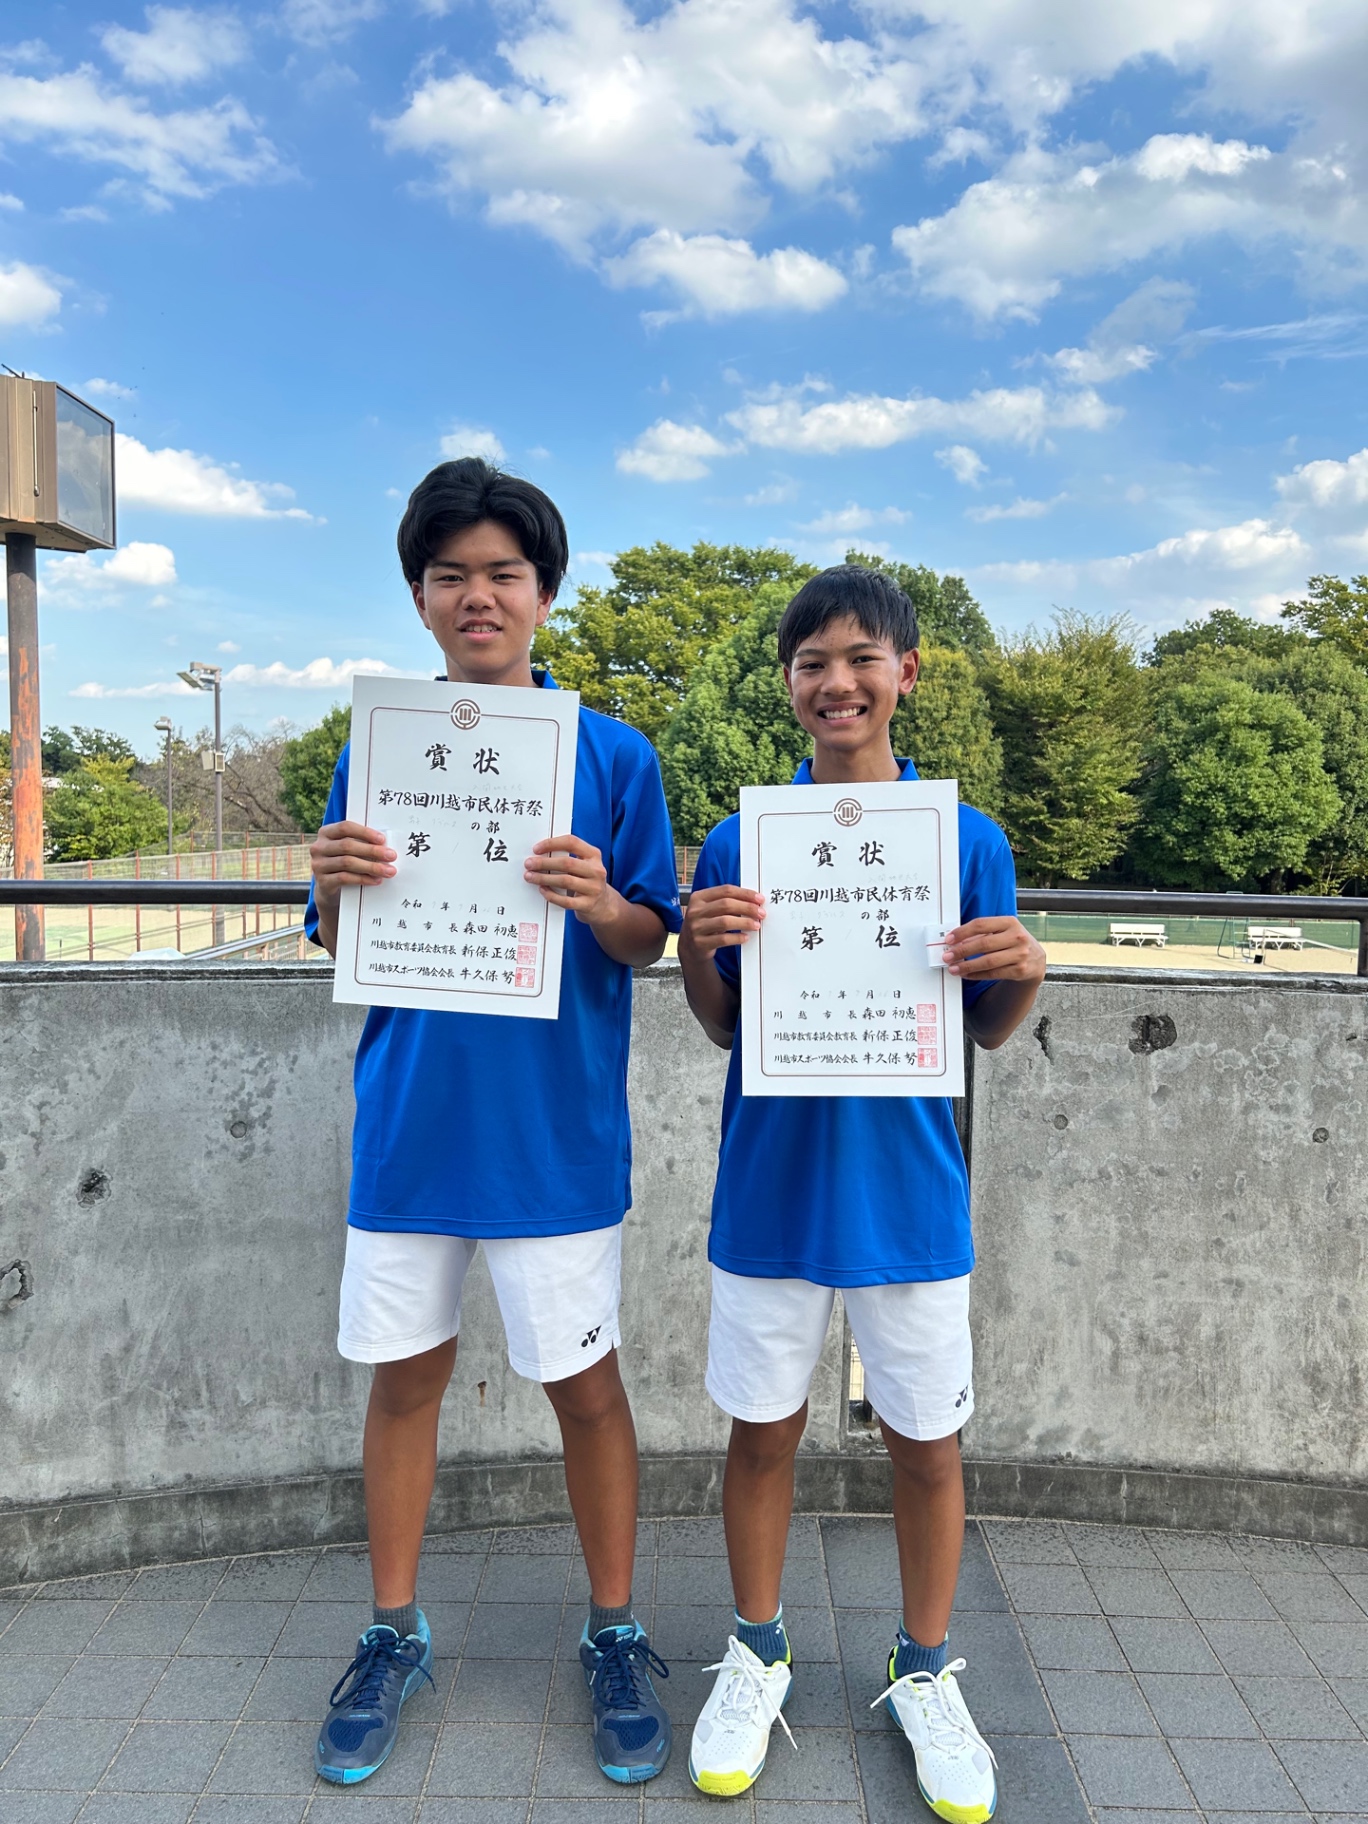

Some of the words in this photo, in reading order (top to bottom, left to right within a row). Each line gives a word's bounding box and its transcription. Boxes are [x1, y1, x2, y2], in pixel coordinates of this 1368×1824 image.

[424, 744, 500, 776] 賞状
[470, 820, 500, 834] の部
[810, 840, 886, 868] 賞状
[860, 908, 890, 922] の部
